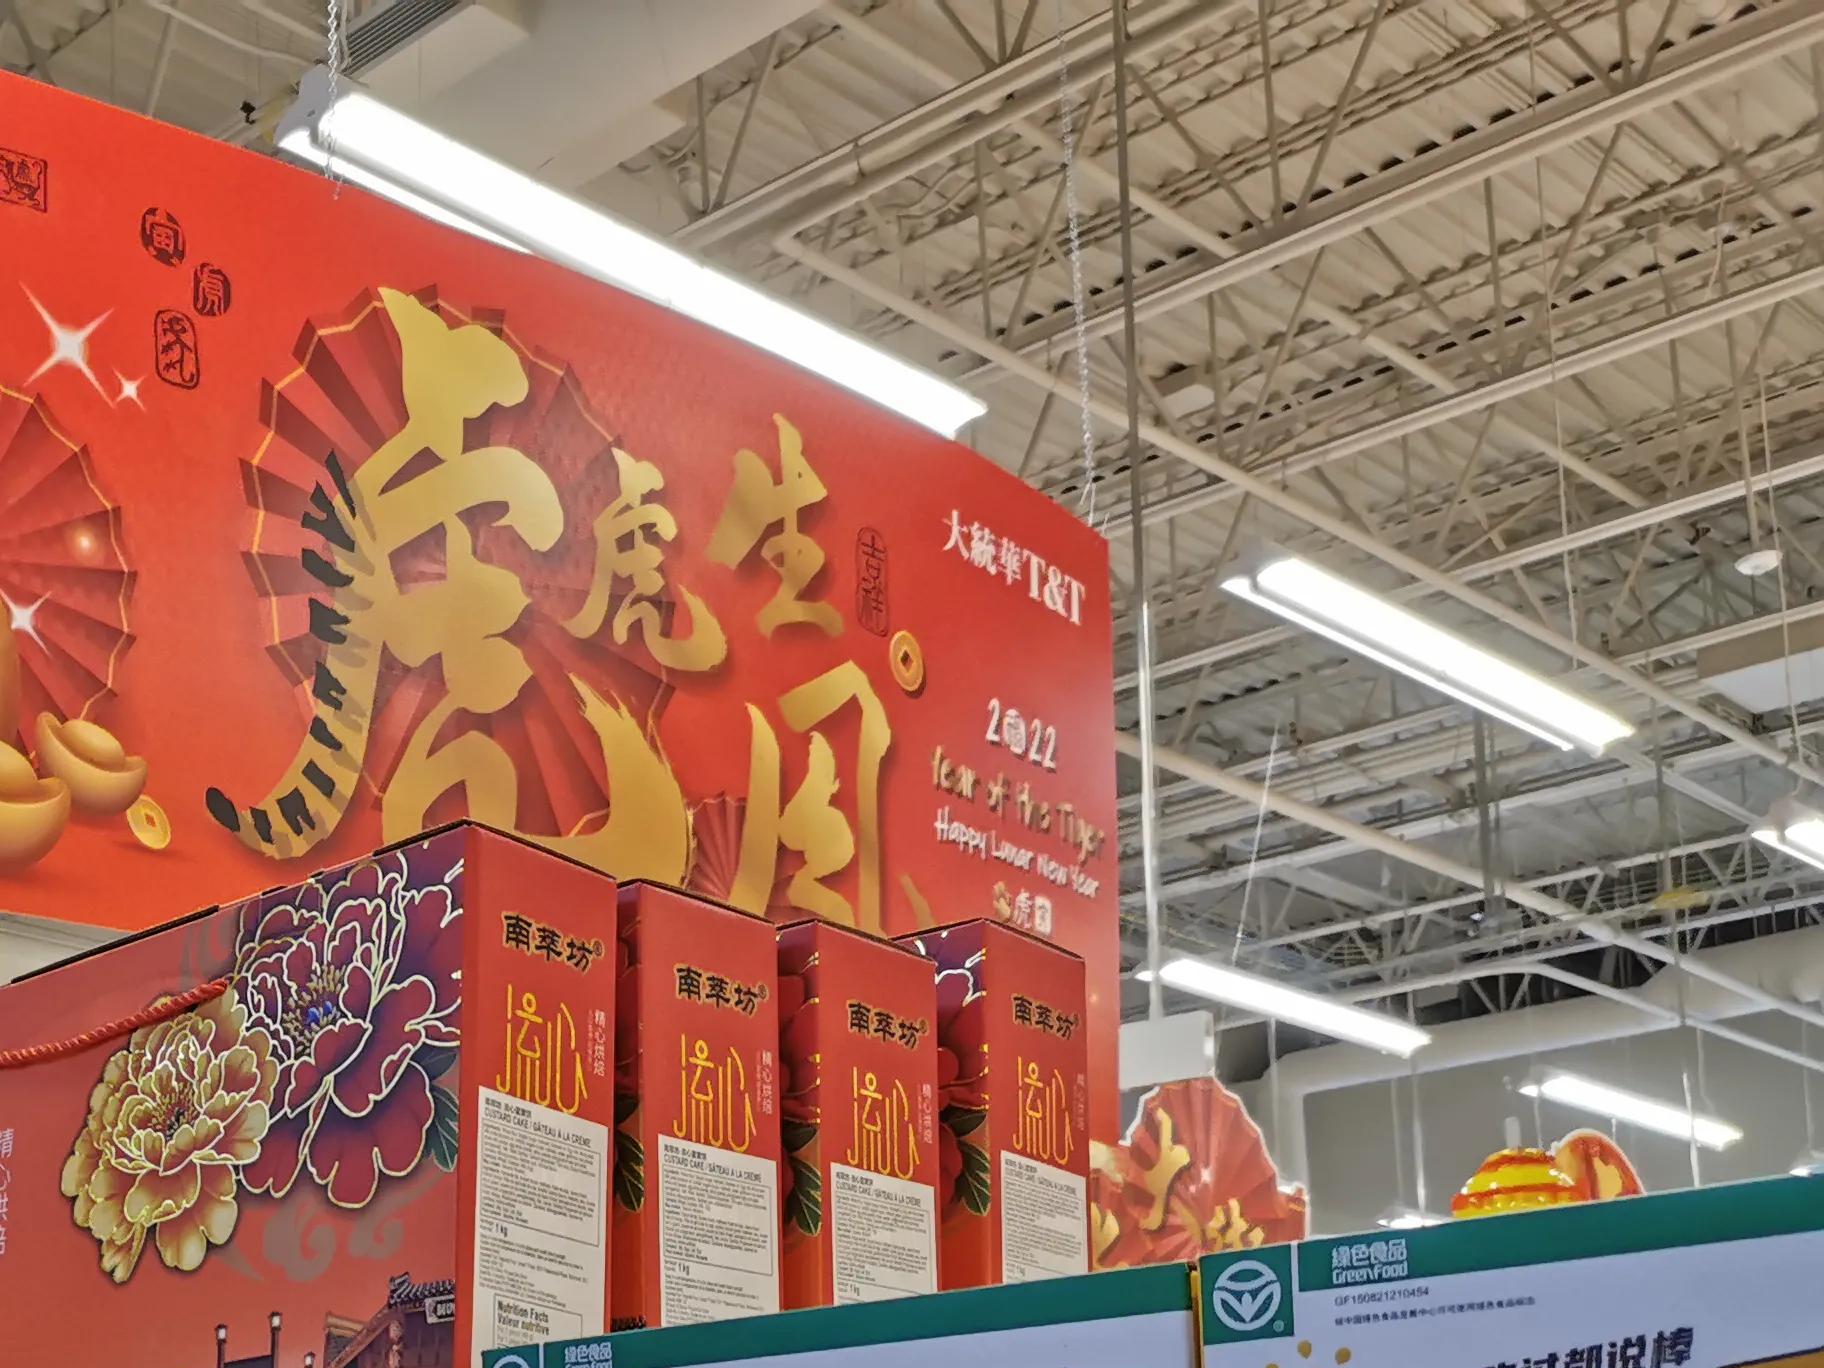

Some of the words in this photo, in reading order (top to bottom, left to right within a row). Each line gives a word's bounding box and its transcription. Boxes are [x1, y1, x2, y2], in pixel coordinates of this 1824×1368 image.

[934, 805, 987, 860] Happy
[990, 829, 1035, 871] Lunar
[497, 1299, 529, 1319] Nutrition
[529, 1308, 550, 1325] Facts
[497, 1312, 520, 1328] Valeur
